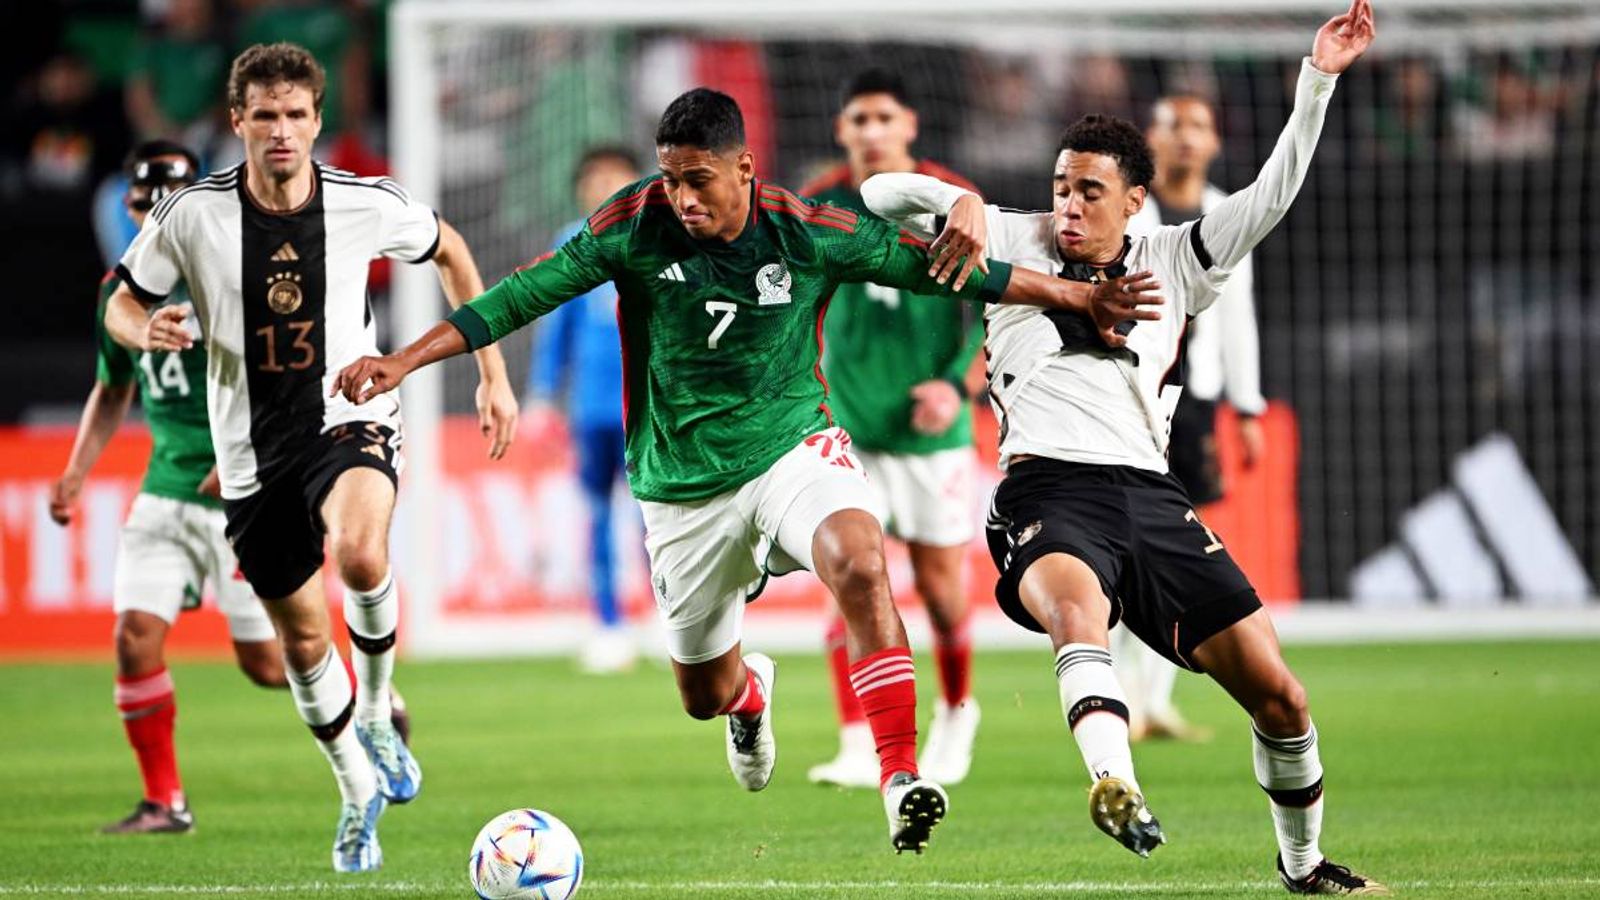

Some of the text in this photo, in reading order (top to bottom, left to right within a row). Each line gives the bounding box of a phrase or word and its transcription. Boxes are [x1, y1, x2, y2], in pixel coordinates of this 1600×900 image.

[256, 320, 315, 373] 13
[705, 301, 737, 350] 7
[139, 351, 191, 399] 14
